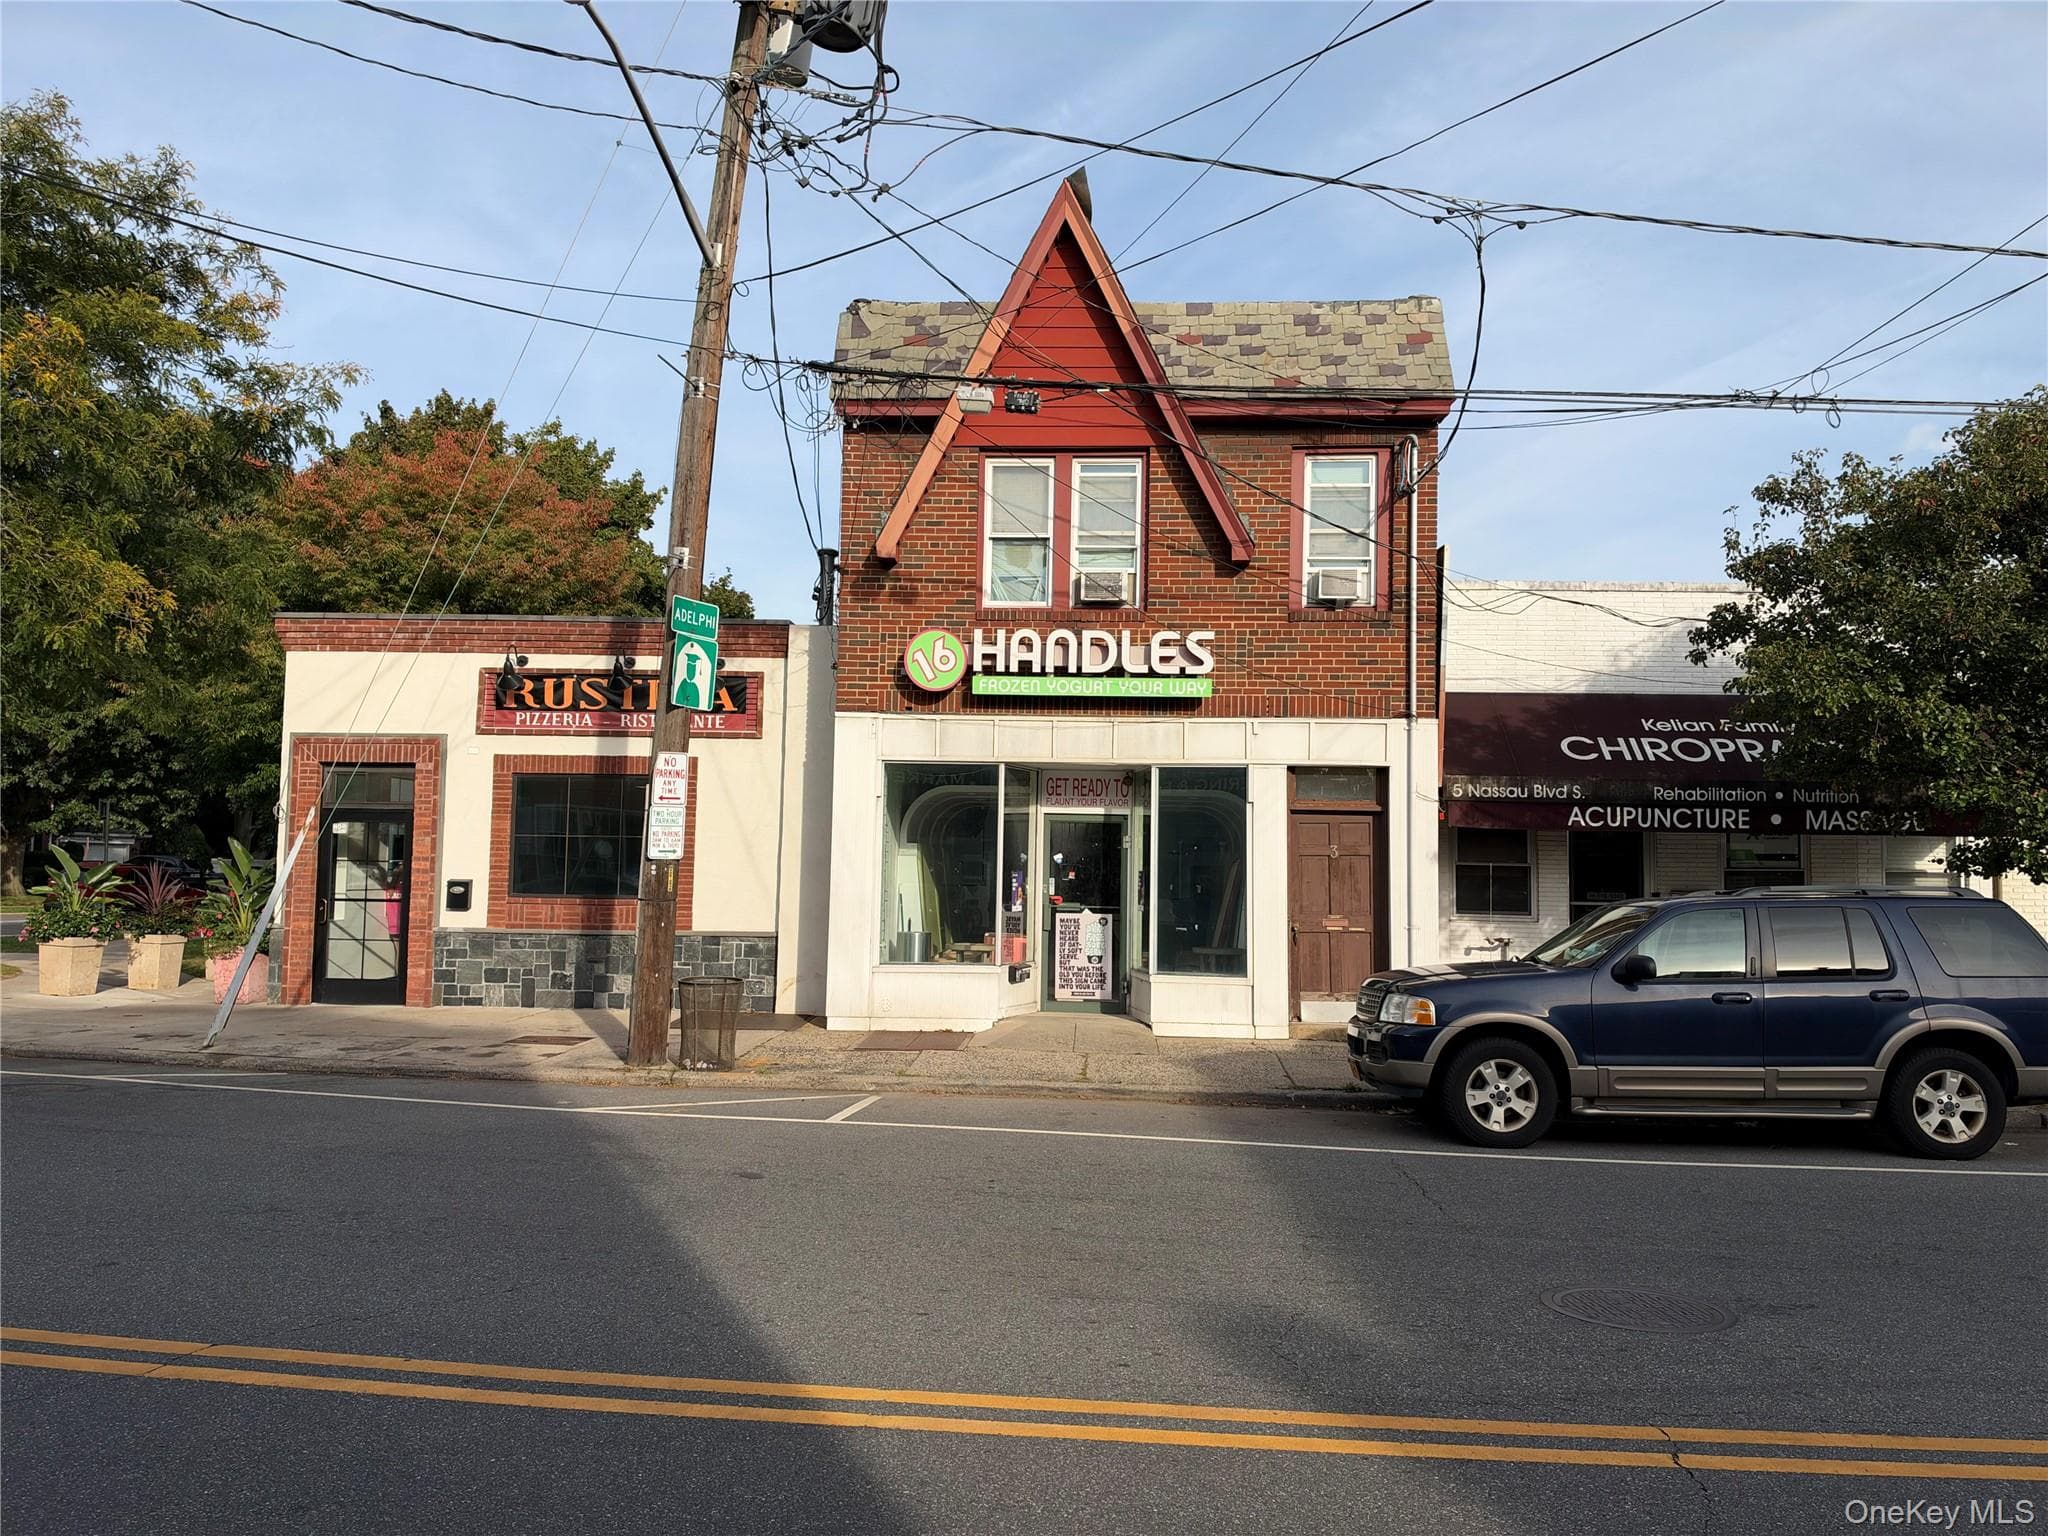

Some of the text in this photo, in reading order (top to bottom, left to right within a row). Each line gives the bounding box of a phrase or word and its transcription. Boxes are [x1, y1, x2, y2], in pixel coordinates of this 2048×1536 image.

[674, 607, 716, 630] ADELPHI
[912, 634, 957, 683] 16
[973, 629, 1215, 674] HANDLES
[979, 680, 1208, 695] FROZEN YOGURT YOUR WAY
[515, 712, 593, 728] PIZZERIA
[1641, 719, 1715, 732] Kelian
[664, 757, 677, 767] NO
[656, 768, 686, 780] PARKING
[661, 787, 678, 795] TIME
[1046, 777, 1130, 798] GET READY TO
[1452, 784, 1586, 799] 5 Nassau Blvd S.
[1653, 786, 1860, 804] Rehabilitation Nutrition
[1046, 797, 1129, 807] FLAUNT YOUR FLAVOR
[655, 817, 680, 825] PARKING
[667, 810, 682, 818] HOUR
[1567, 806, 1750, 829] ACUPUNCTURE
[1330, 845, 1338, 858] 3
